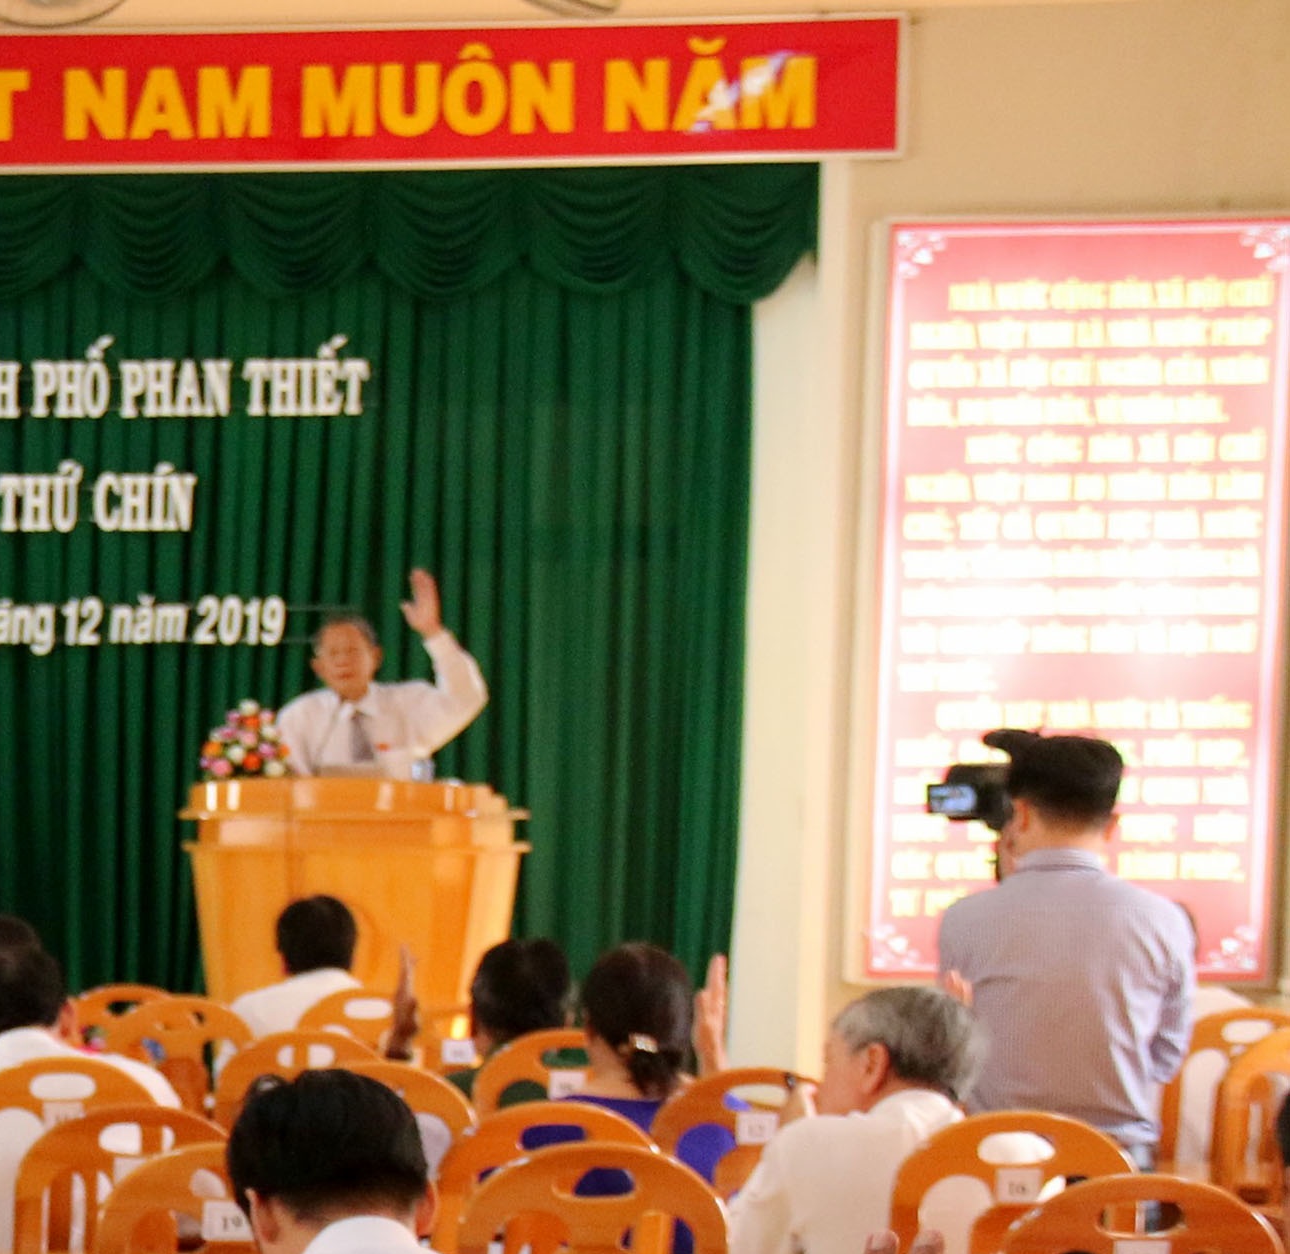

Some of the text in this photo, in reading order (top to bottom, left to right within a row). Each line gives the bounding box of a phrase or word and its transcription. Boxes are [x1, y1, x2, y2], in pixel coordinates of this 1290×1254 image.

[63, 65, 272, 141] NAM
[300, 43, 575, 139] MUÔN
[603, 37, 817, 134] NĂM
[30, 334, 114, 419] PHỐ
[119, 357, 232, 419] PHAN
[242, 333, 370, 417] THIẾT
[92, 460, 197, 532] CHÍN
[61, 596, 103, 646] 12
[108, 593, 189, 645] năm
[193, 594, 286, 646] 2019
